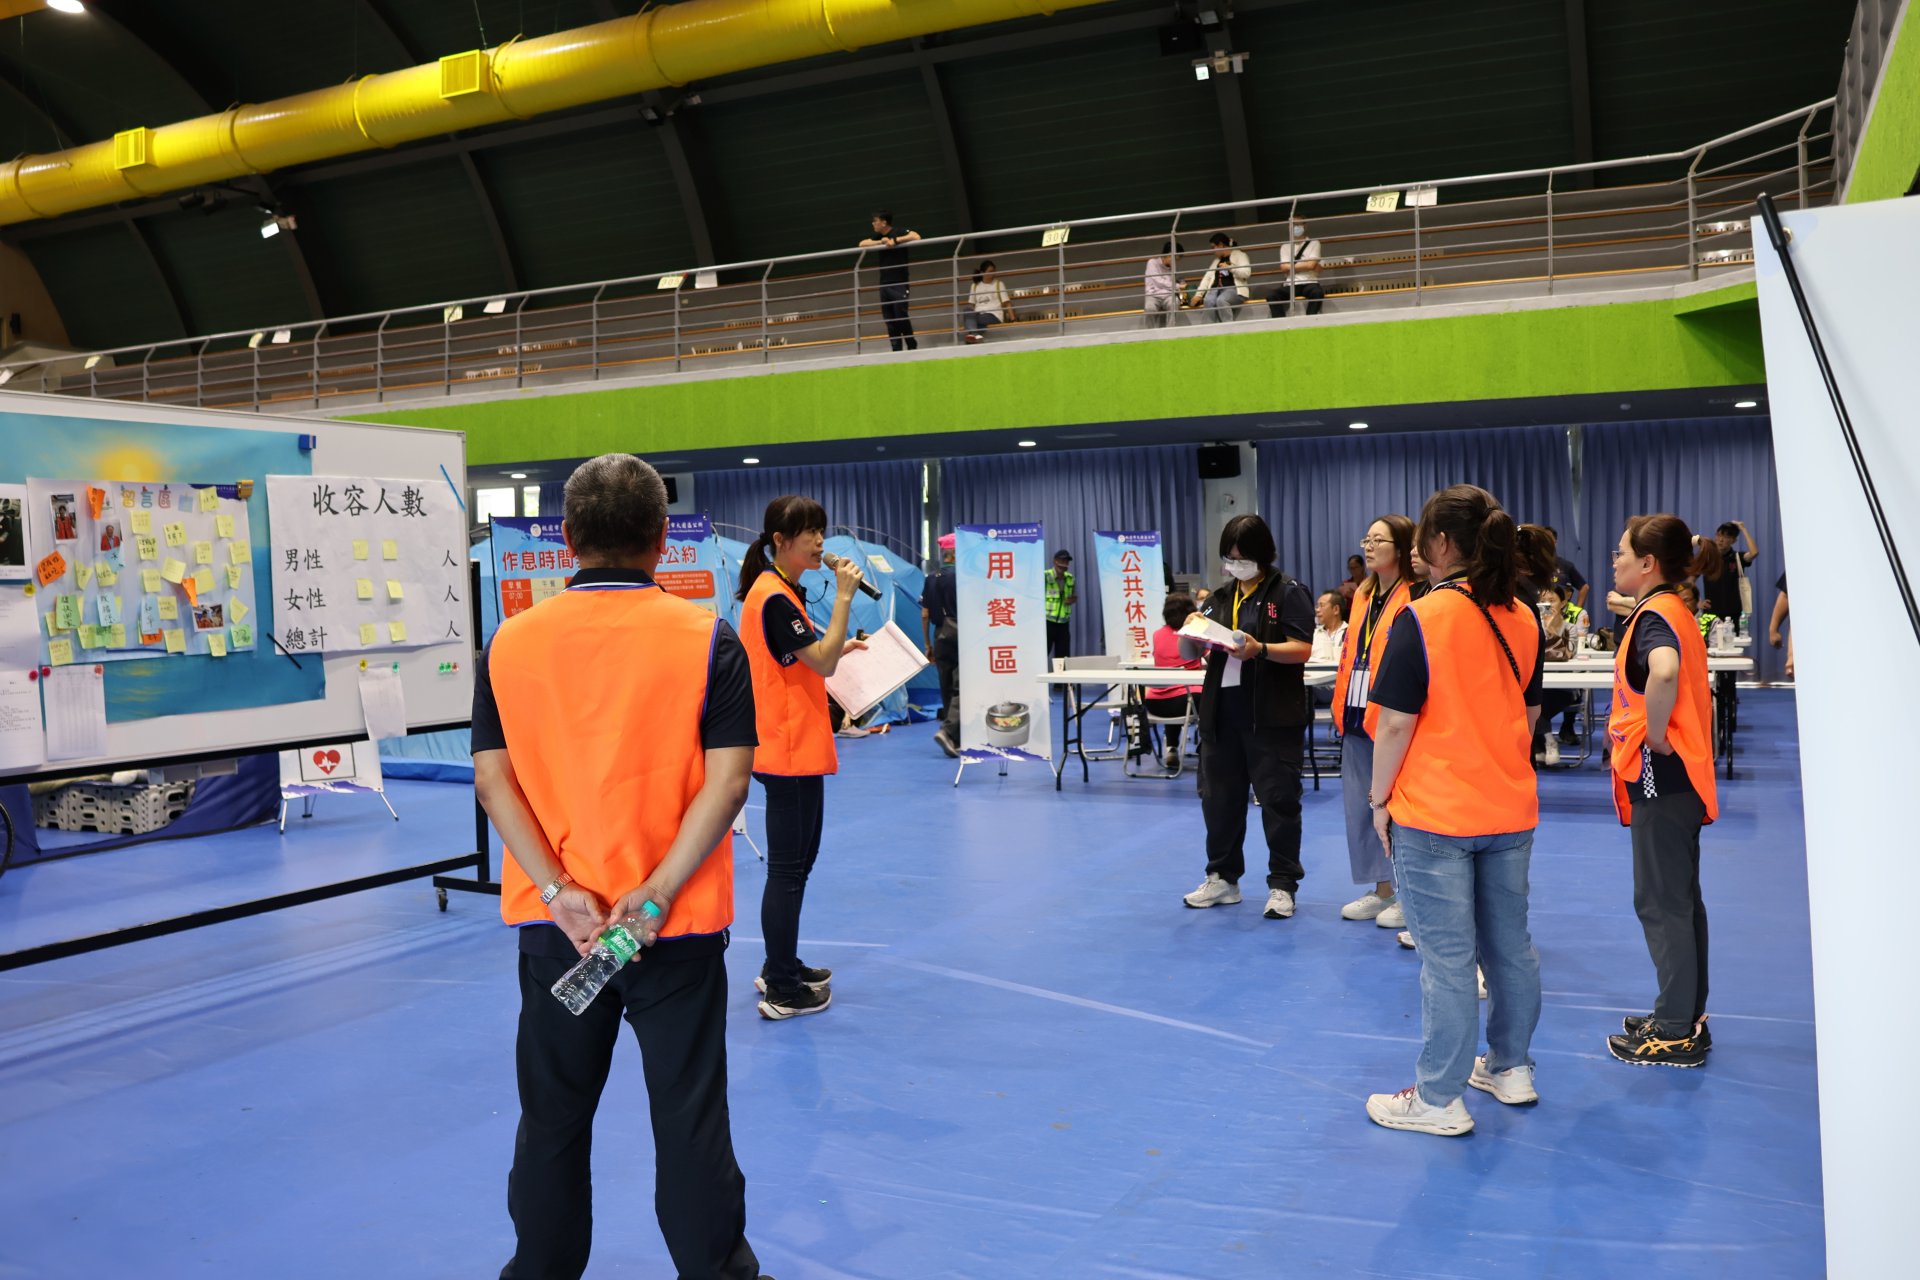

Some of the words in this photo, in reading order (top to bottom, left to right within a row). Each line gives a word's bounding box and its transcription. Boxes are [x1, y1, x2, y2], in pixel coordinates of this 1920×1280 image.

[1369, 196, 1395, 209] 307
[313, 484, 427, 518] 收容人數
[284, 548, 324, 572] 男性
[442, 549, 458, 567] 人
[502, 550, 580, 571] 作息時間
[284, 588, 327, 611] 女性
[444, 585, 460, 602] 人
[1120, 550, 1152, 658] 公共休息
[986, 551, 1018, 674] 用餐區
[285, 626, 328, 650] 總計
[446, 620, 461, 638] 人
